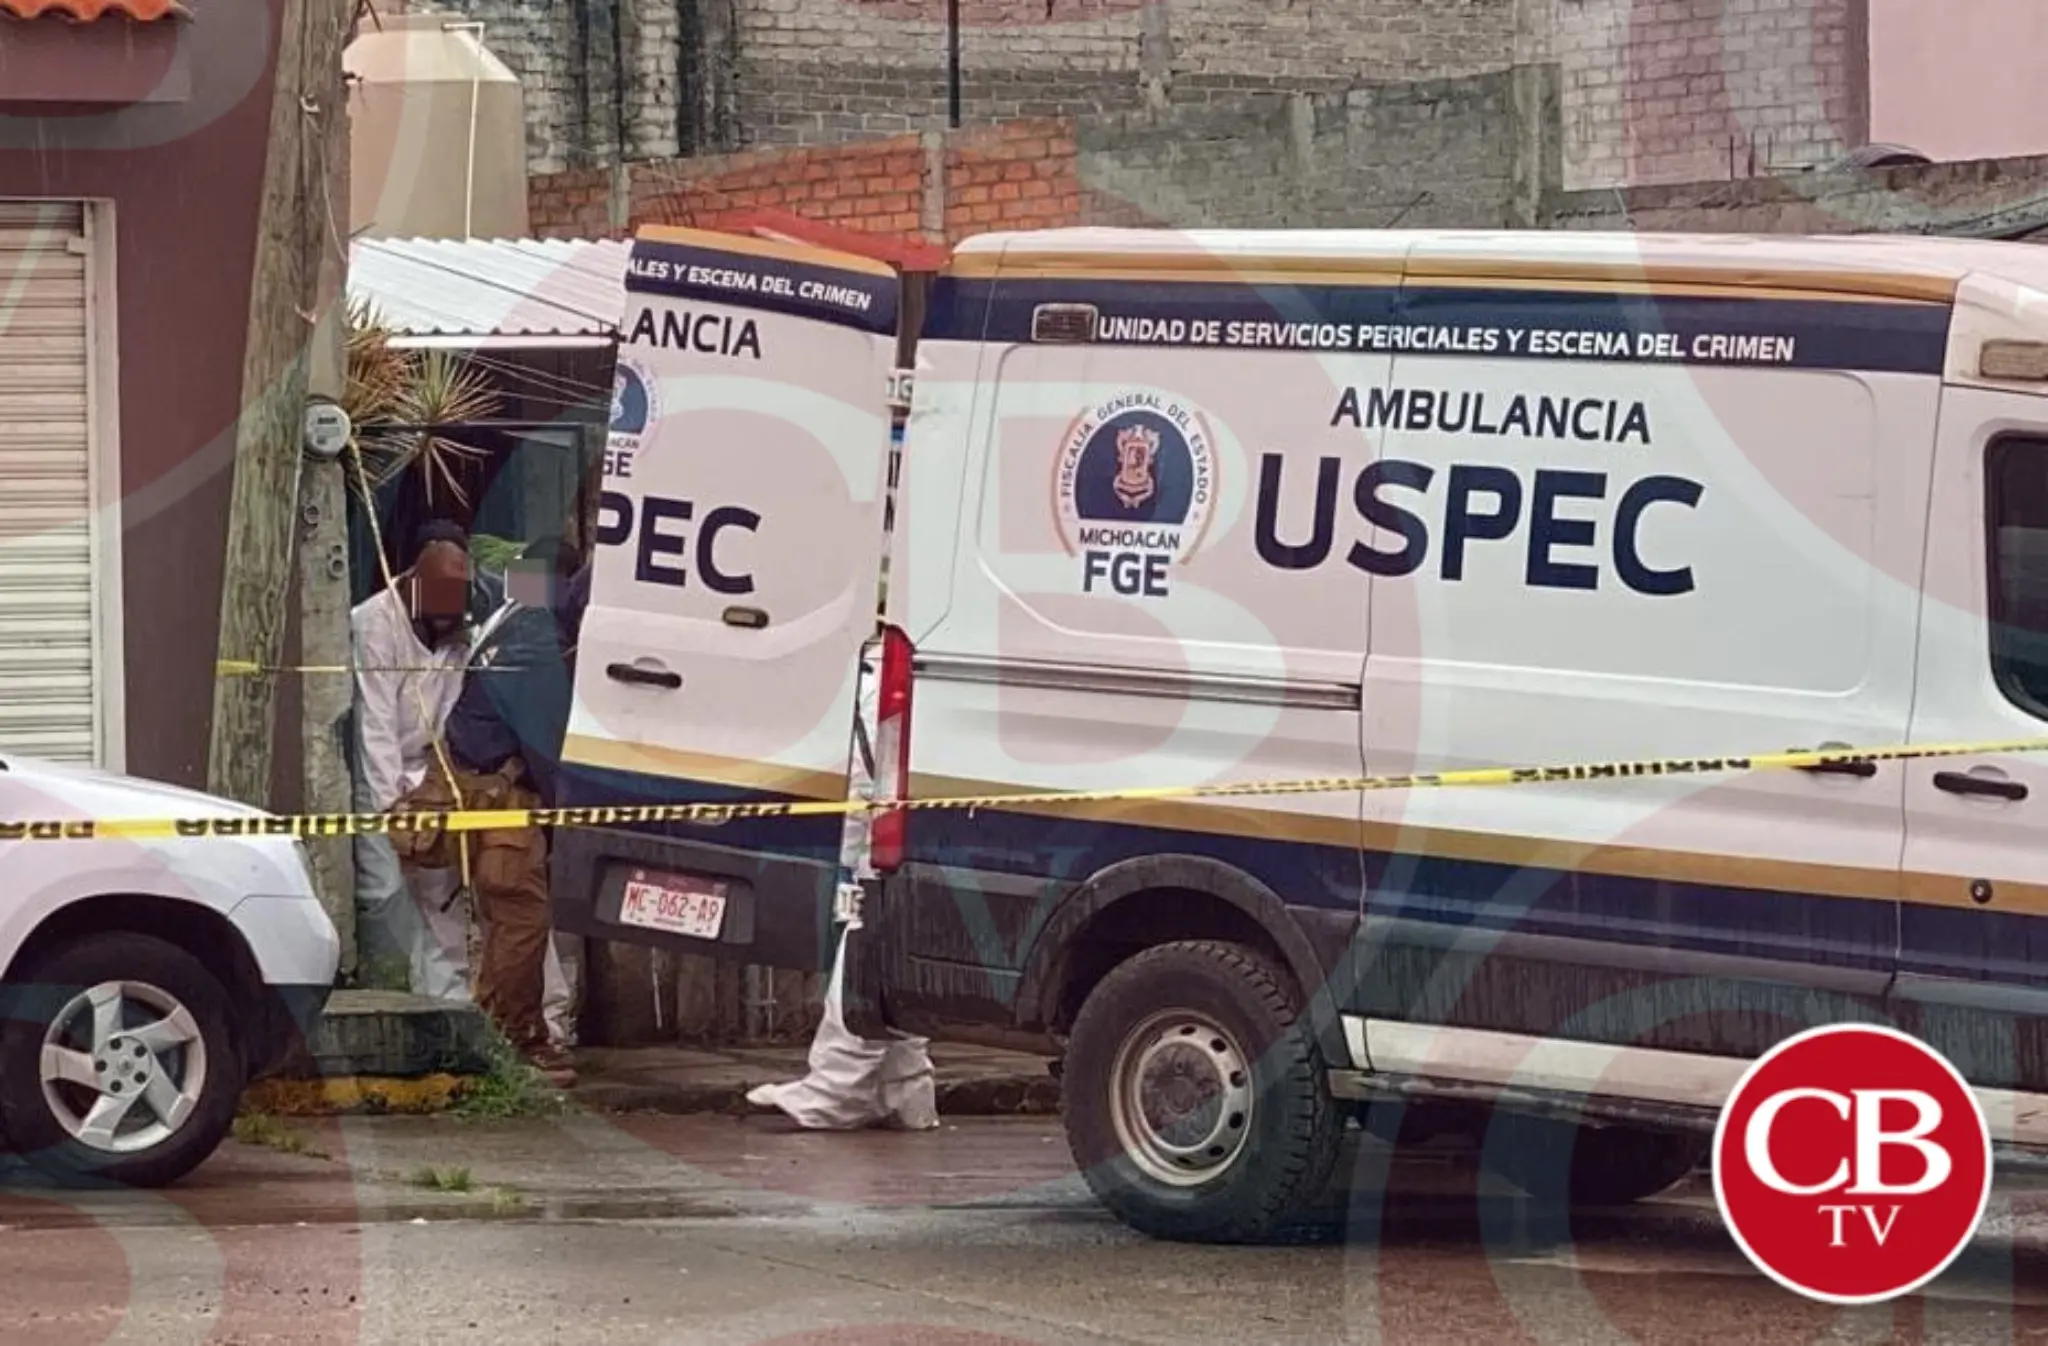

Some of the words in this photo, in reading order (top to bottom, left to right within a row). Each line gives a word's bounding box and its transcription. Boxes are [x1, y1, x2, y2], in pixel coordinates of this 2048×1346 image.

[674, 263, 687, 281] Y
[688, 267, 757, 291] ESCENA
[762, 276, 794, 296] DEL
[799, 281, 871, 310] CRIMEN
[1099, 316, 1184, 342] UNIDAD
[1190, 320, 1221, 343] DE
[1225, 322, 1351, 347] SERVICIOS
[1357, 325, 1499, 350] PERICIALES
[1506, 330, 1524, 352] Y
[1528, 331, 1630, 355] ESCENA
[1637, 334, 1685, 357] DEL
[1692, 335, 1795, 361] CRIMEN
[1331, 387, 1651, 444] AMBULANCIA
[1096, 393, 1162, 421] GENERAL
[1167, 404, 1191, 429] DEL
[1190, 434, 1212, 505] ESTADO
[595, 490, 761, 594] PEC
[1079, 528, 1181, 549] MICHOACÁN
[1254, 453, 1705, 596] USPEC
[1083, 550, 1171, 597] FGE
